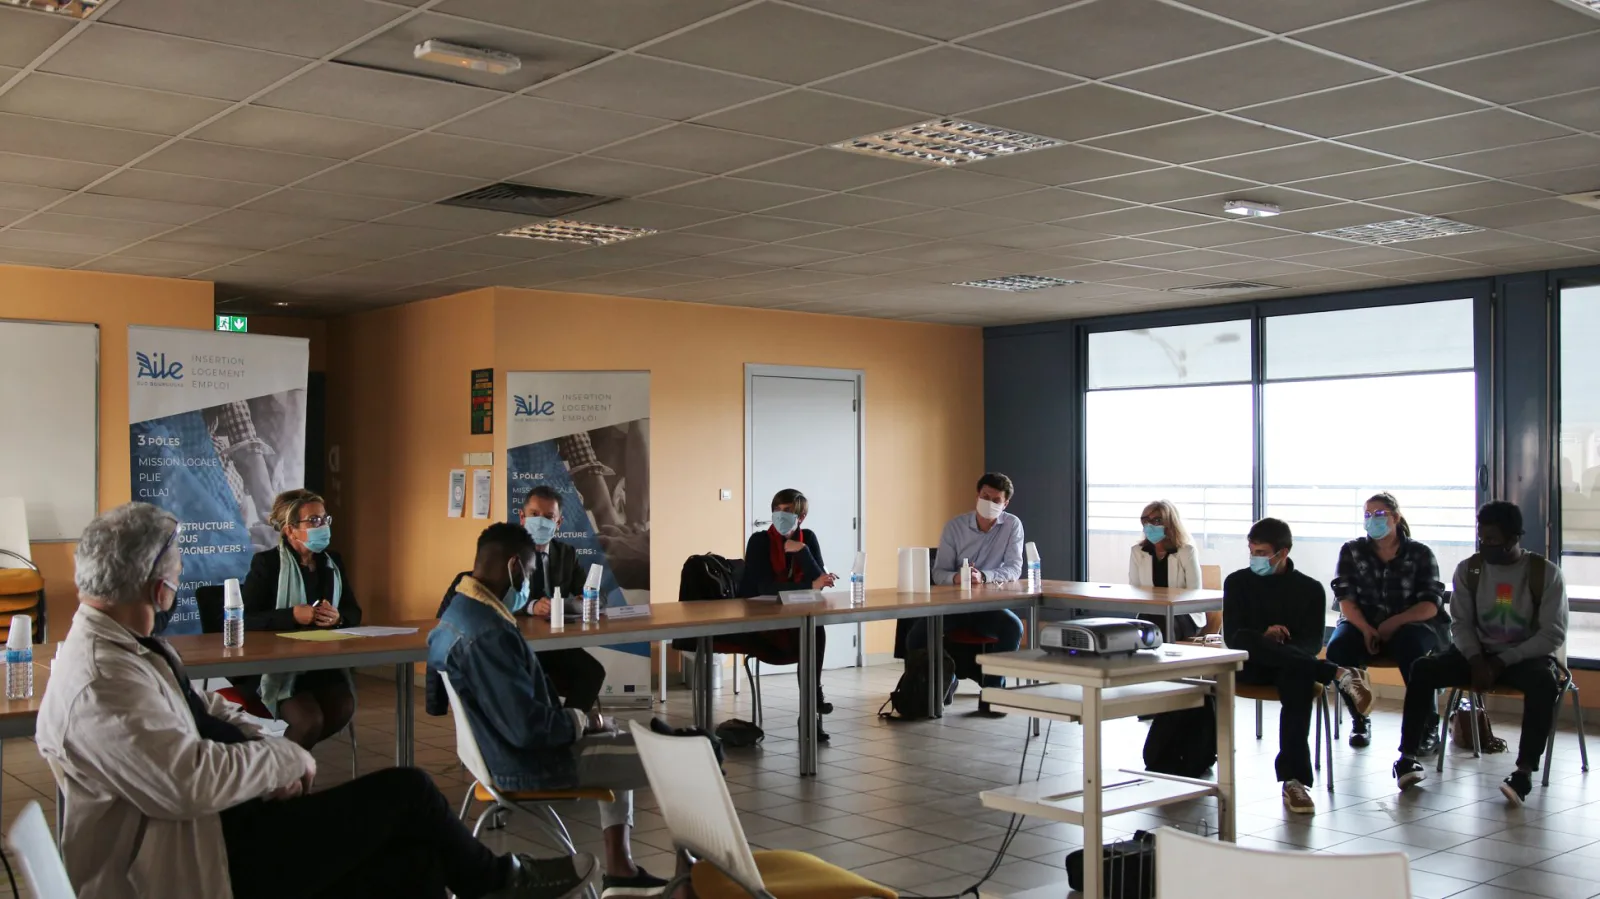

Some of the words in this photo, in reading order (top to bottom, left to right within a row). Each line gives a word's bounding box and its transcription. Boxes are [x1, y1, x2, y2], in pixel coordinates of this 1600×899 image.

[136, 351, 184, 379] Aile
[191, 355, 245, 365] INSERTION
[191, 368, 246, 378] LOGEMENT
[191, 380, 230, 390] EMPLOI
[562, 393, 612, 401] INSERTION
[513, 394, 555, 416] Aile
[562, 404, 612, 412] LOGEMENT
[137, 434, 145, 446] 3
[148, 435, 180, 446] PÔLES
[138, 457, 179, 467] MISSION
[181, 457, 218, 467] LOCALE
[139, 472, 162, 482] PLIE
[512, 472, 518, 480] 3
[519, 472, 544, 480] PÔLES
[139, 488, 169, 497] CLLAJ
[181, 521, 235, 531] STRUCTURE
[178, 534, 198, 543] OUS
[178, 546, 215, 555] PAGNER
[217, 544, 241, 553] VERS
[178, 580, 212, 591] MATION
